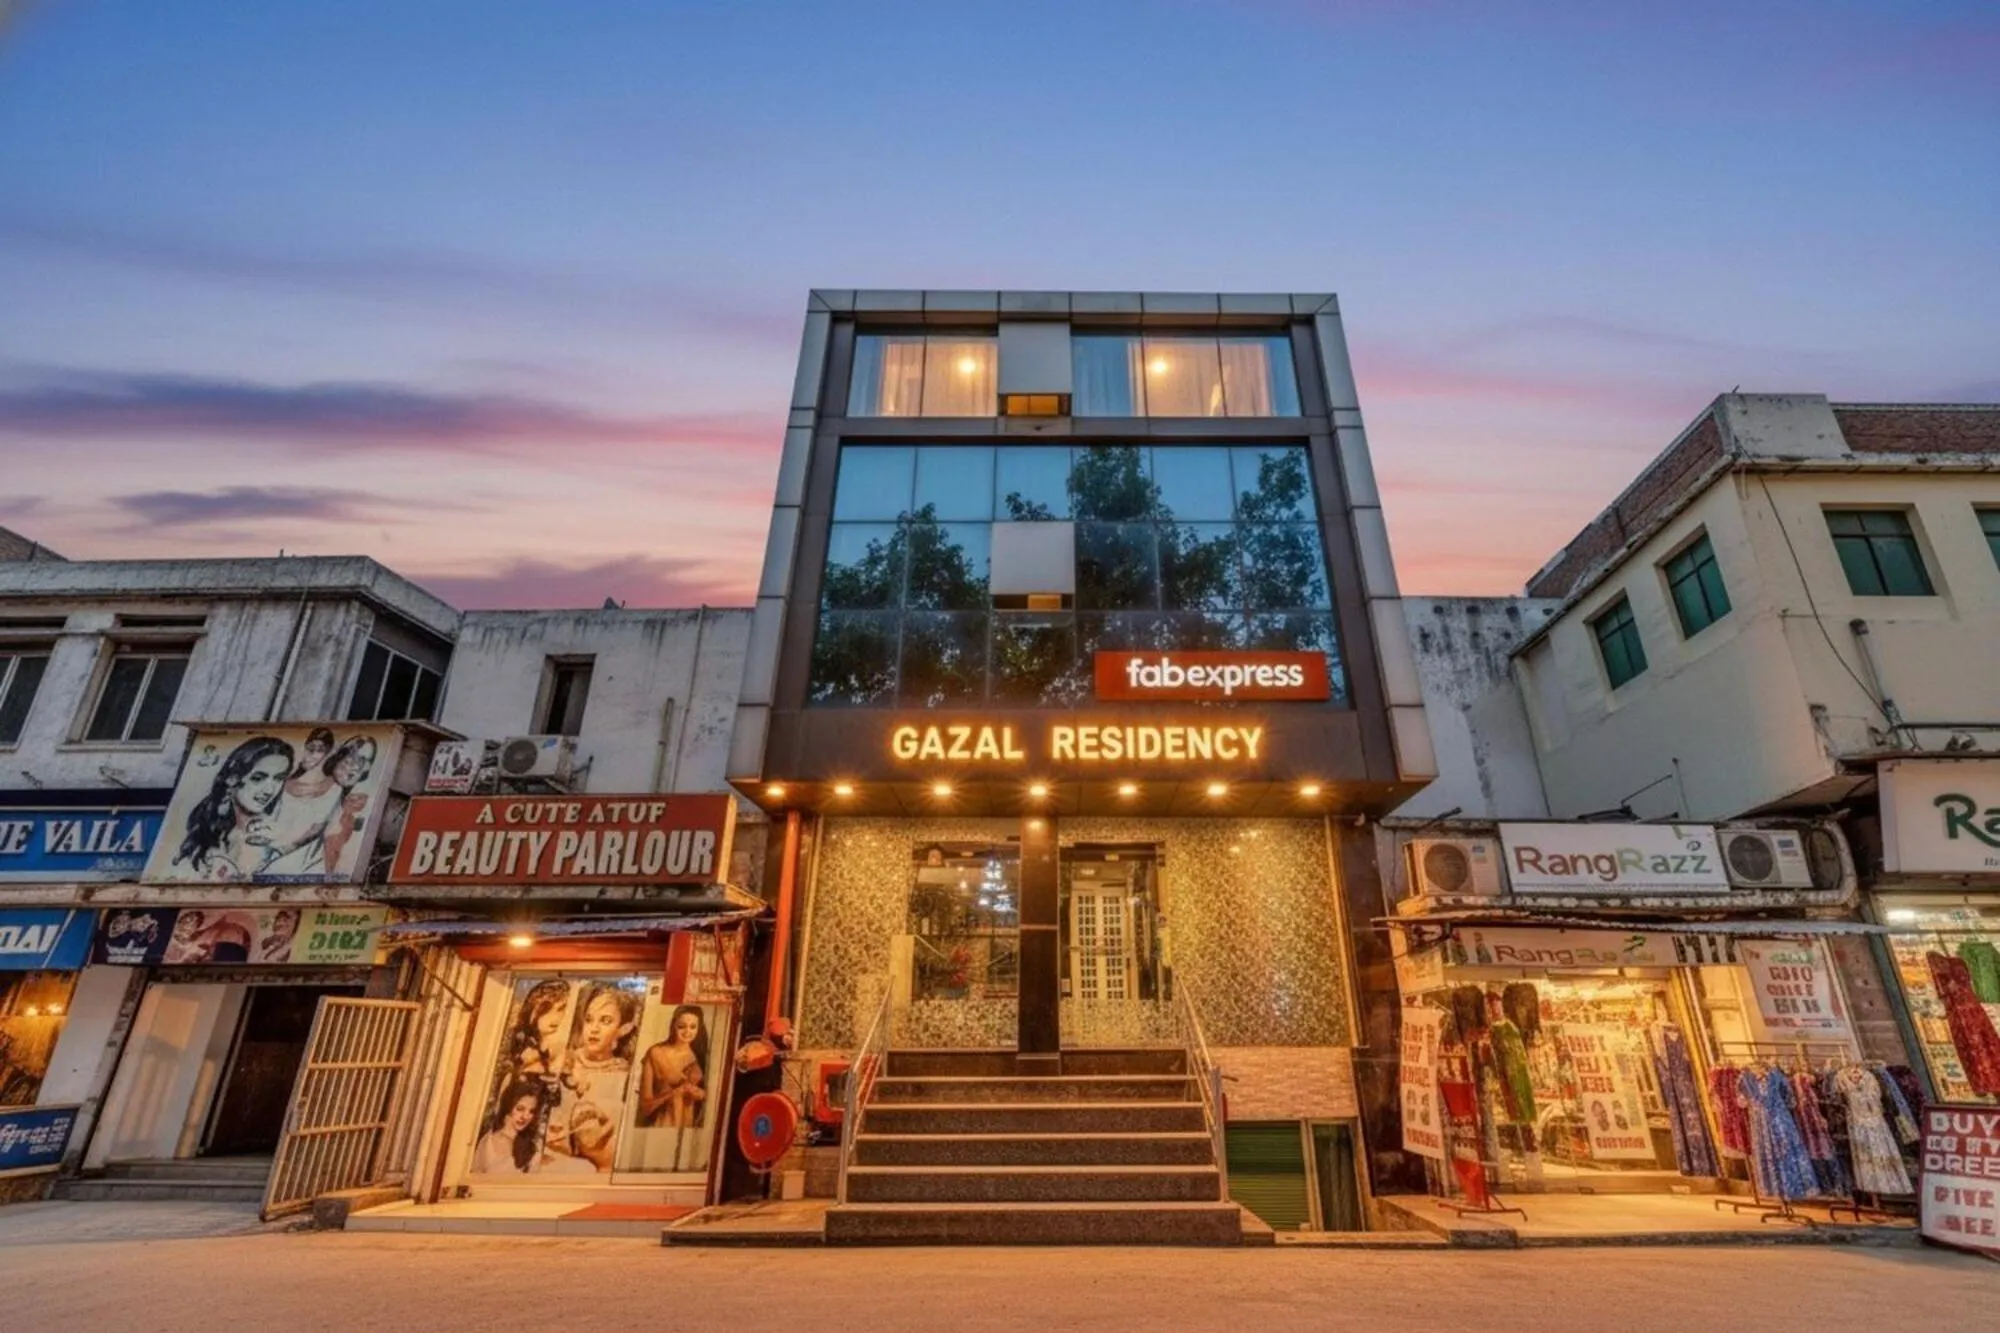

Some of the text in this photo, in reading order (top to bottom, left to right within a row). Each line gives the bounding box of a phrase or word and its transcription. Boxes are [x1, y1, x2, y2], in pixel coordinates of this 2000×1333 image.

[1127, 658, 1303, 695] fabexpress
[893, 725, 1263, 760] GAZAL RESIDENCY
[476, 803, 495, 823] A
[505, 803, 582, 823] CUTE
[409, 830, 716, 875] BEAUTY PARLOUR
